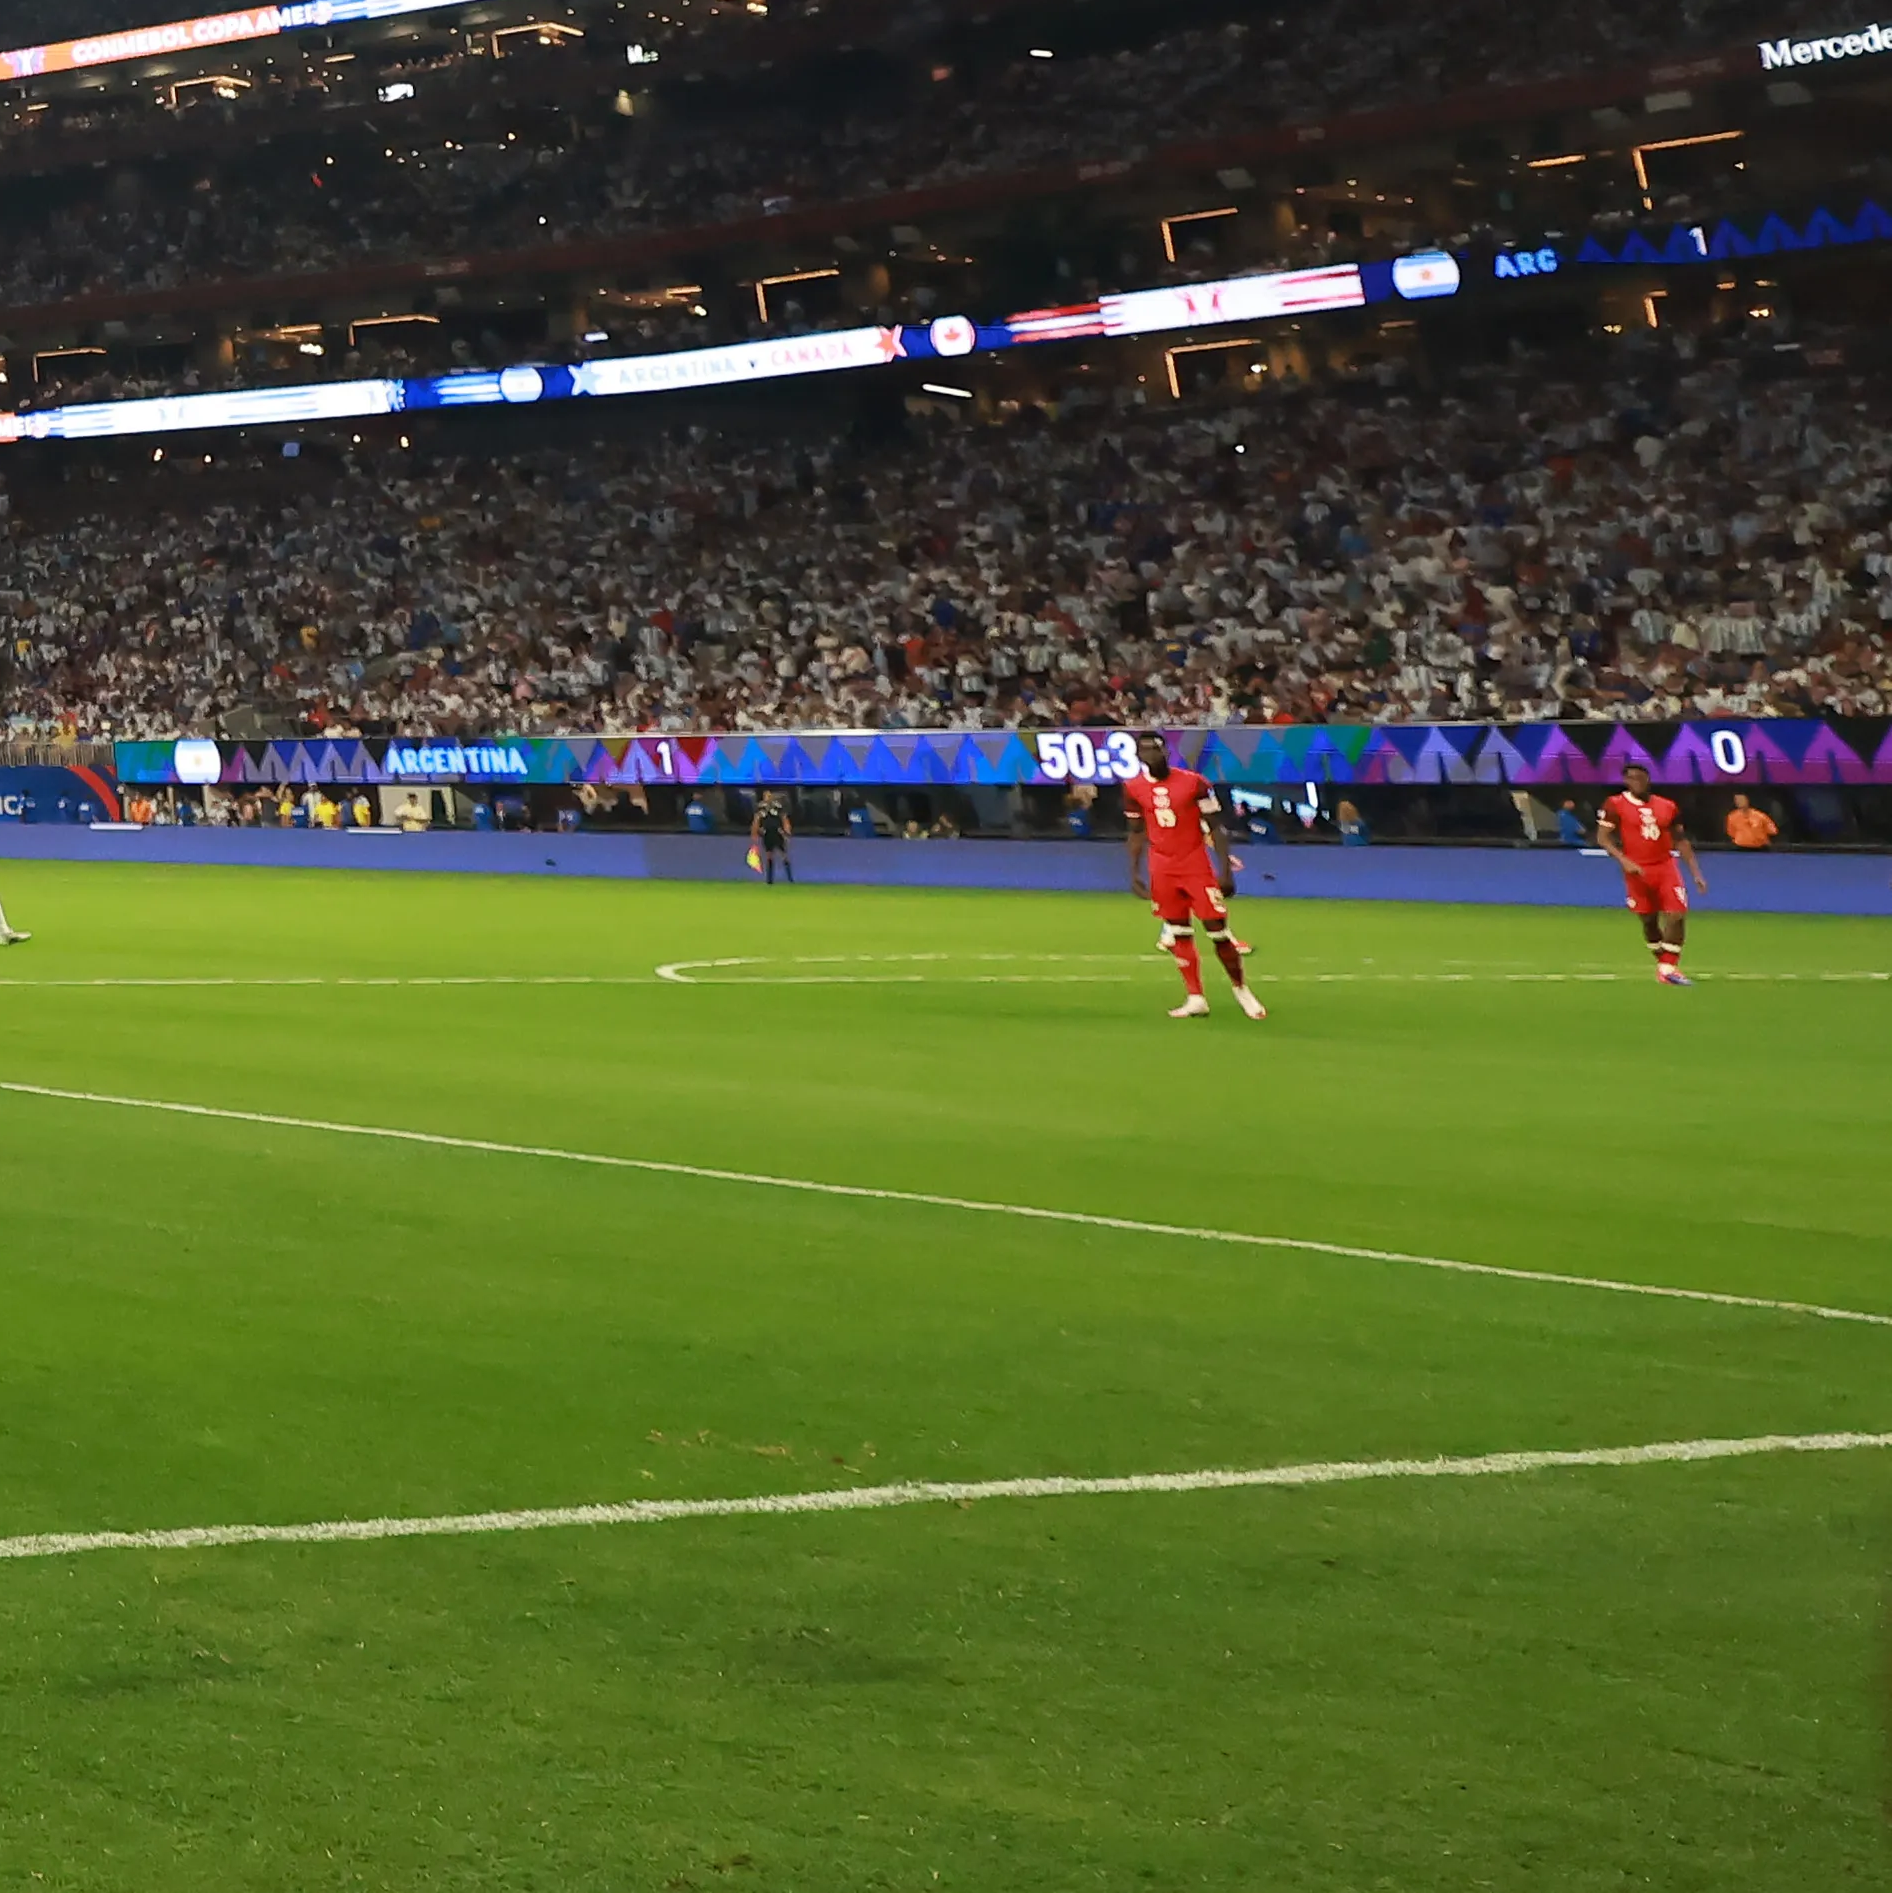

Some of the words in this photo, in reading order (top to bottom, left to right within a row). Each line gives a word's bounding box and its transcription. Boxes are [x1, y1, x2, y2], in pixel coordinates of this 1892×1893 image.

[71, 30, 193, 64] CONMEBOL
[193, 16, 255, 43] COPA
[1494, 246, 1559, 280] ARG
[1687, 224, 1709, 258] 1
[387, 747, 529, 775] ARGENTINA
[655, 740, 673, 776] 1
[1036, 731, 1141, 780] 50:3
[1710, 729, 1746, 775] 0
